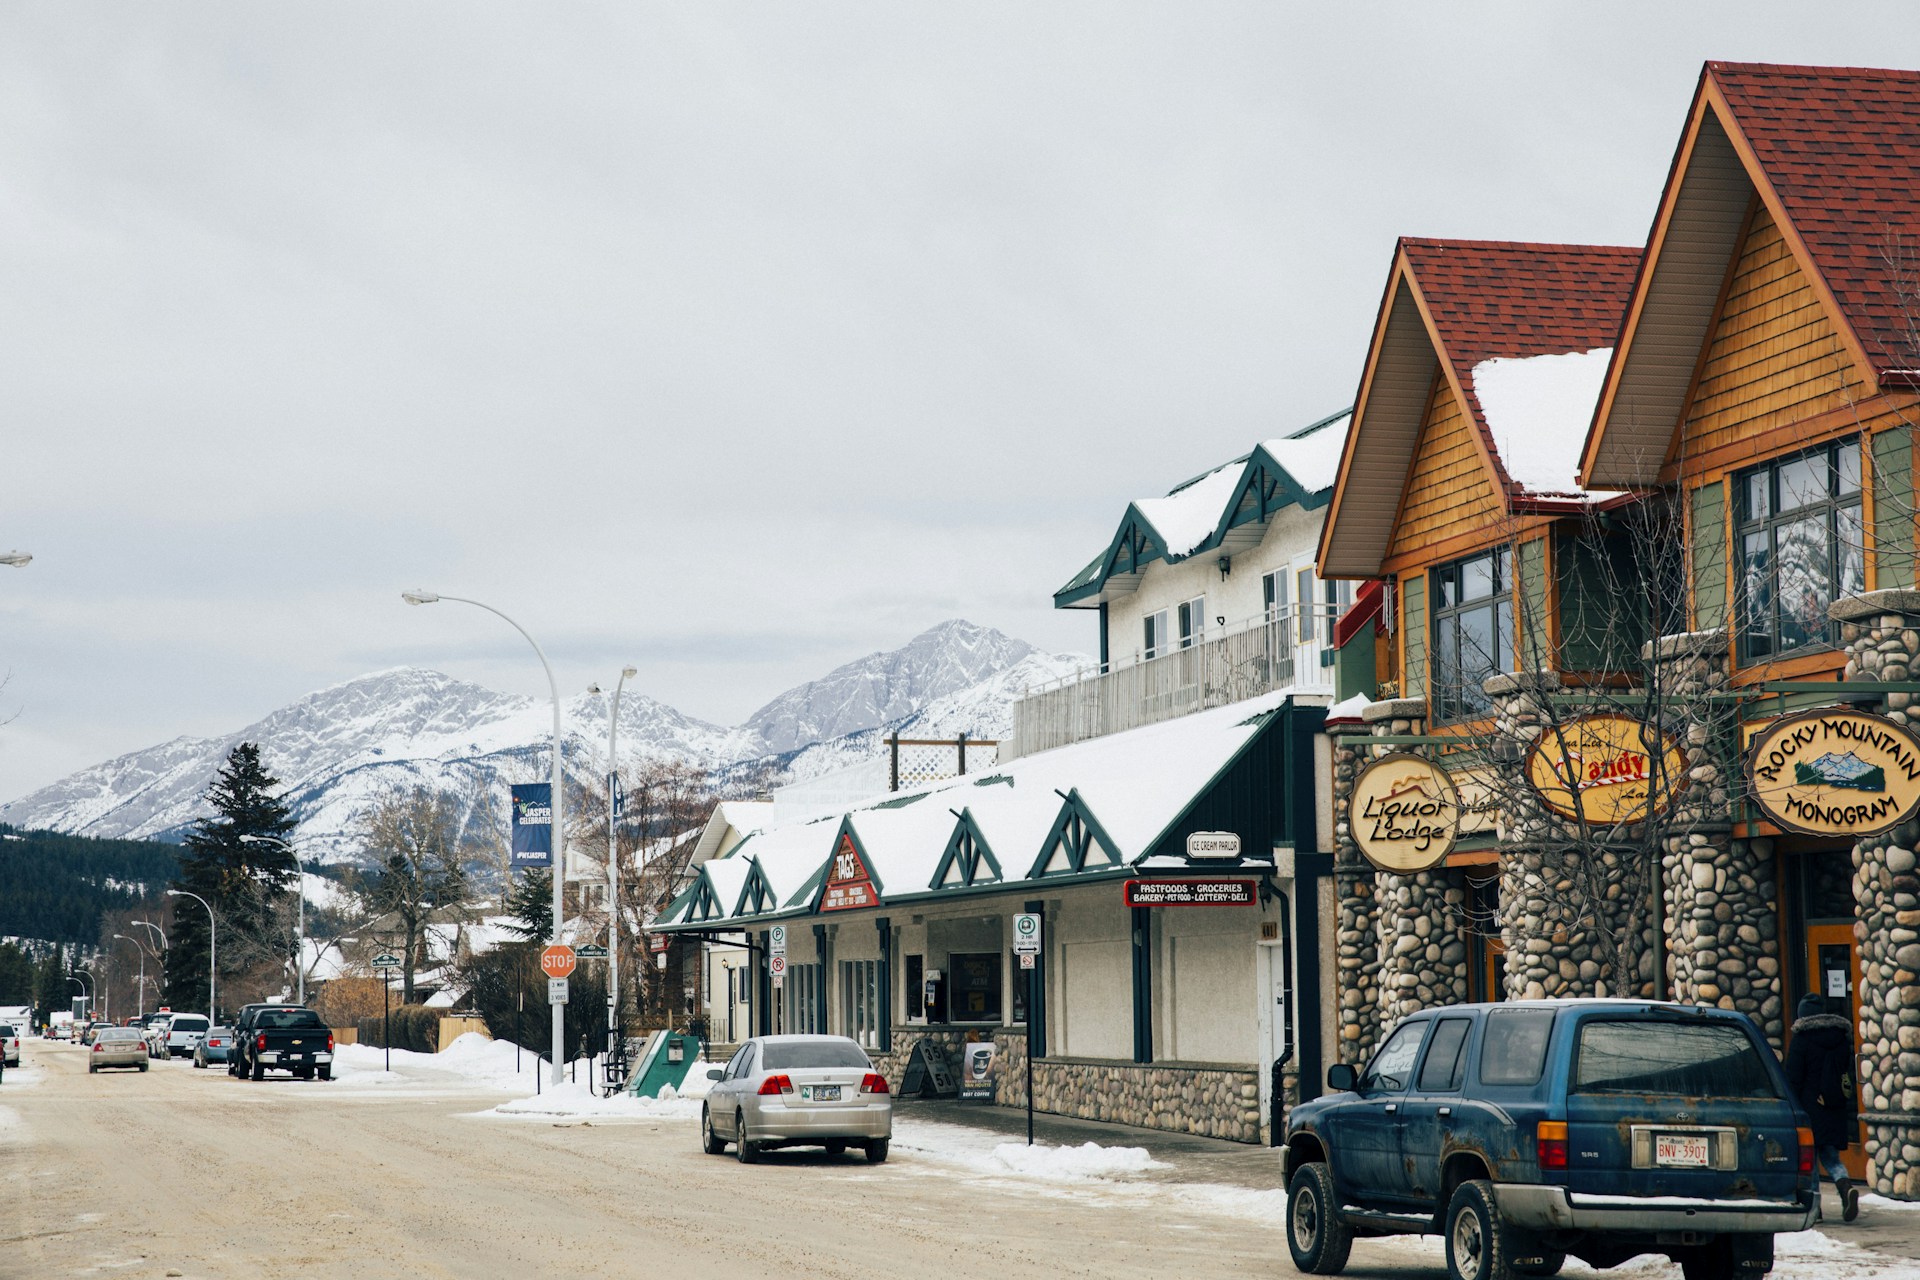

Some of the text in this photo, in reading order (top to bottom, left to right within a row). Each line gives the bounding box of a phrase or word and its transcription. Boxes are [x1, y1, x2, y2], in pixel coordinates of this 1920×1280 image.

[1757, 718, 1920, 782] ROCKY MOUNTAIN
[1555, 751, 1645, 789] Candy
[525, 808, 550, 817] JASPER
[1363, 796, 1448, 829] Liquor
[1785, 792, 1899, 825] MONOGRAM
[519, 817, 551, 825] CELEBRATES
[1370, 819, 1444, 851] Lodge
[1192, 841, 1237, 850] ICE CREAM PARLOR
[837, 853, 854, 880] TAGS
[1140, 884, 1242, 893] FASTFOODS GROCERIES
[1133, 894, 1164, 902] BAKERY
[1194, 894, 1228, 902] LOTTERY
[544, 955, 574, 968] STOP
[1659, 1144, 1706, 1159] BNV-3907
[1741, 1260, 1769, 1268] 4WD
